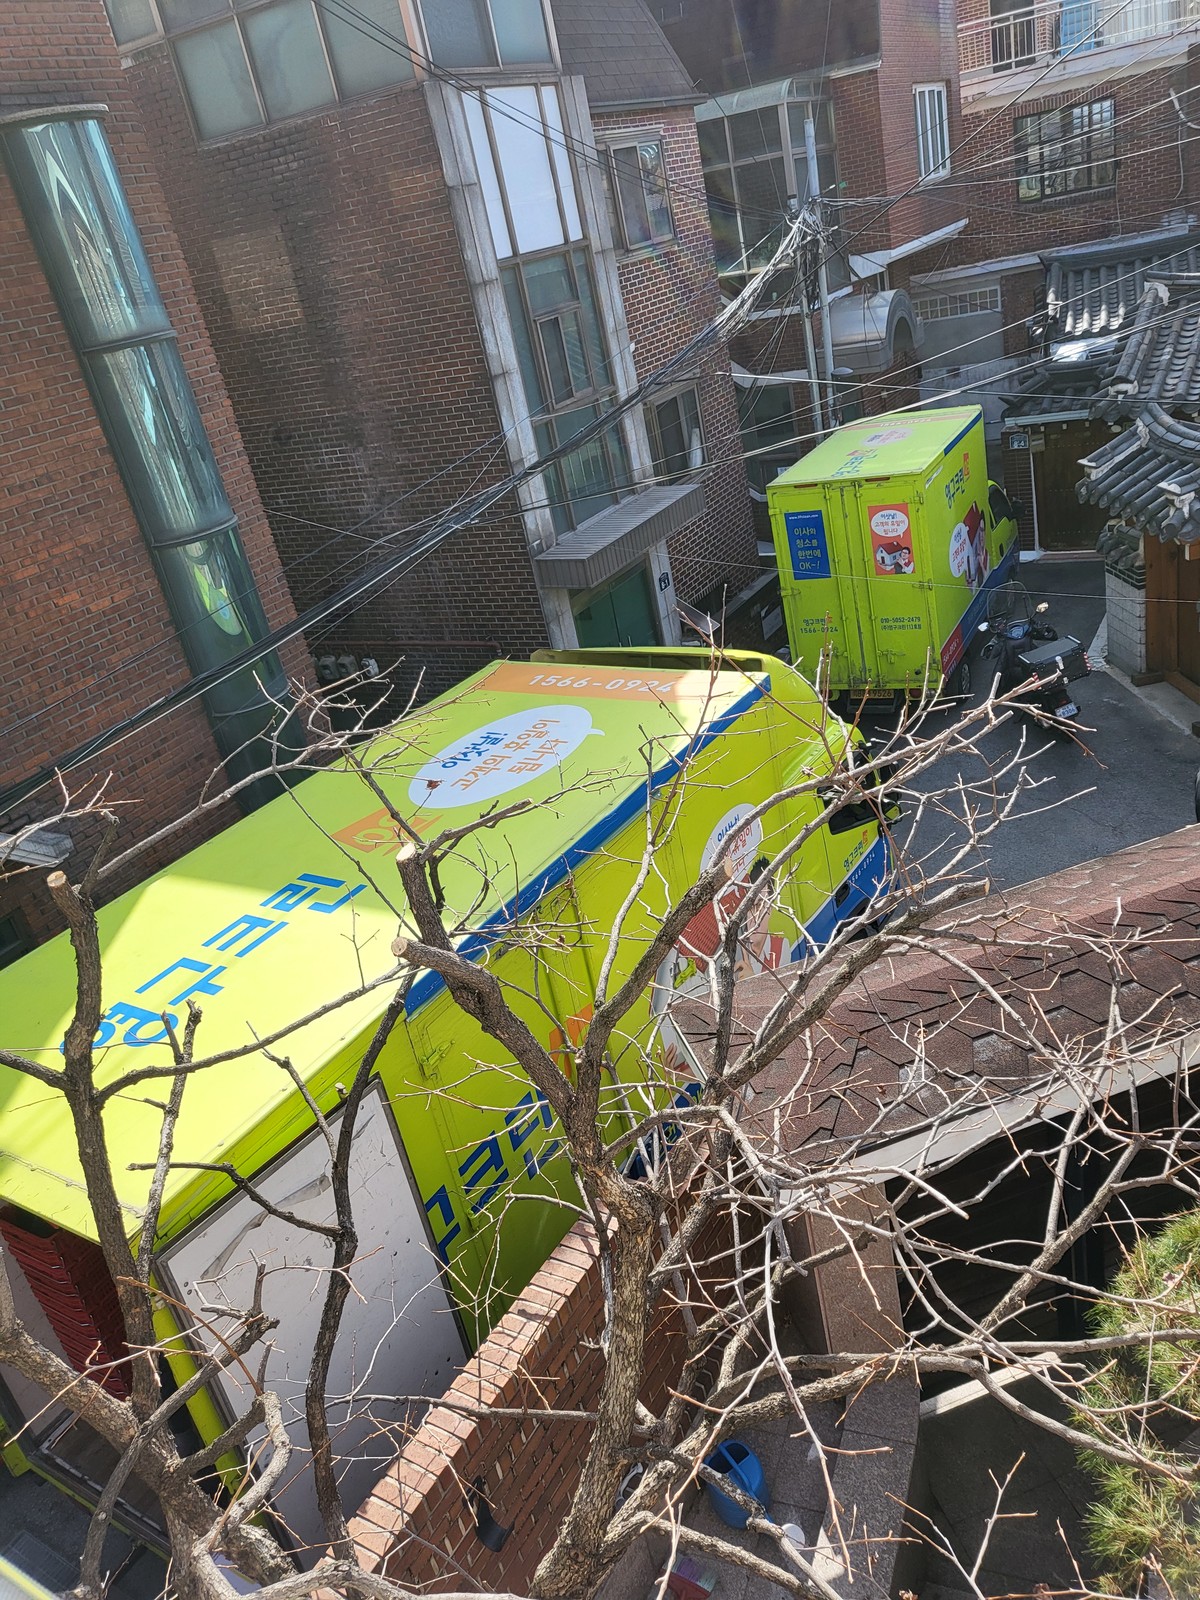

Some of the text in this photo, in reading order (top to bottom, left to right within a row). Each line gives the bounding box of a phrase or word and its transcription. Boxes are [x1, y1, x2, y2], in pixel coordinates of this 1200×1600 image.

[793, 527, 816, 536] 이사와
[796, 539, 818, 548] 청소를
[798, 549, 821, 559] 한번에
[529, 673, 676, 694] 1566-0924
[441, 731, 508, 769] 이삿날!
[507, 738, 569, 774] 됩니다
[450, 754, 512, 791] 고객의
[850, 850, 876, 884] 566-0924
[60, 872, 369, 1055] 영구크린
